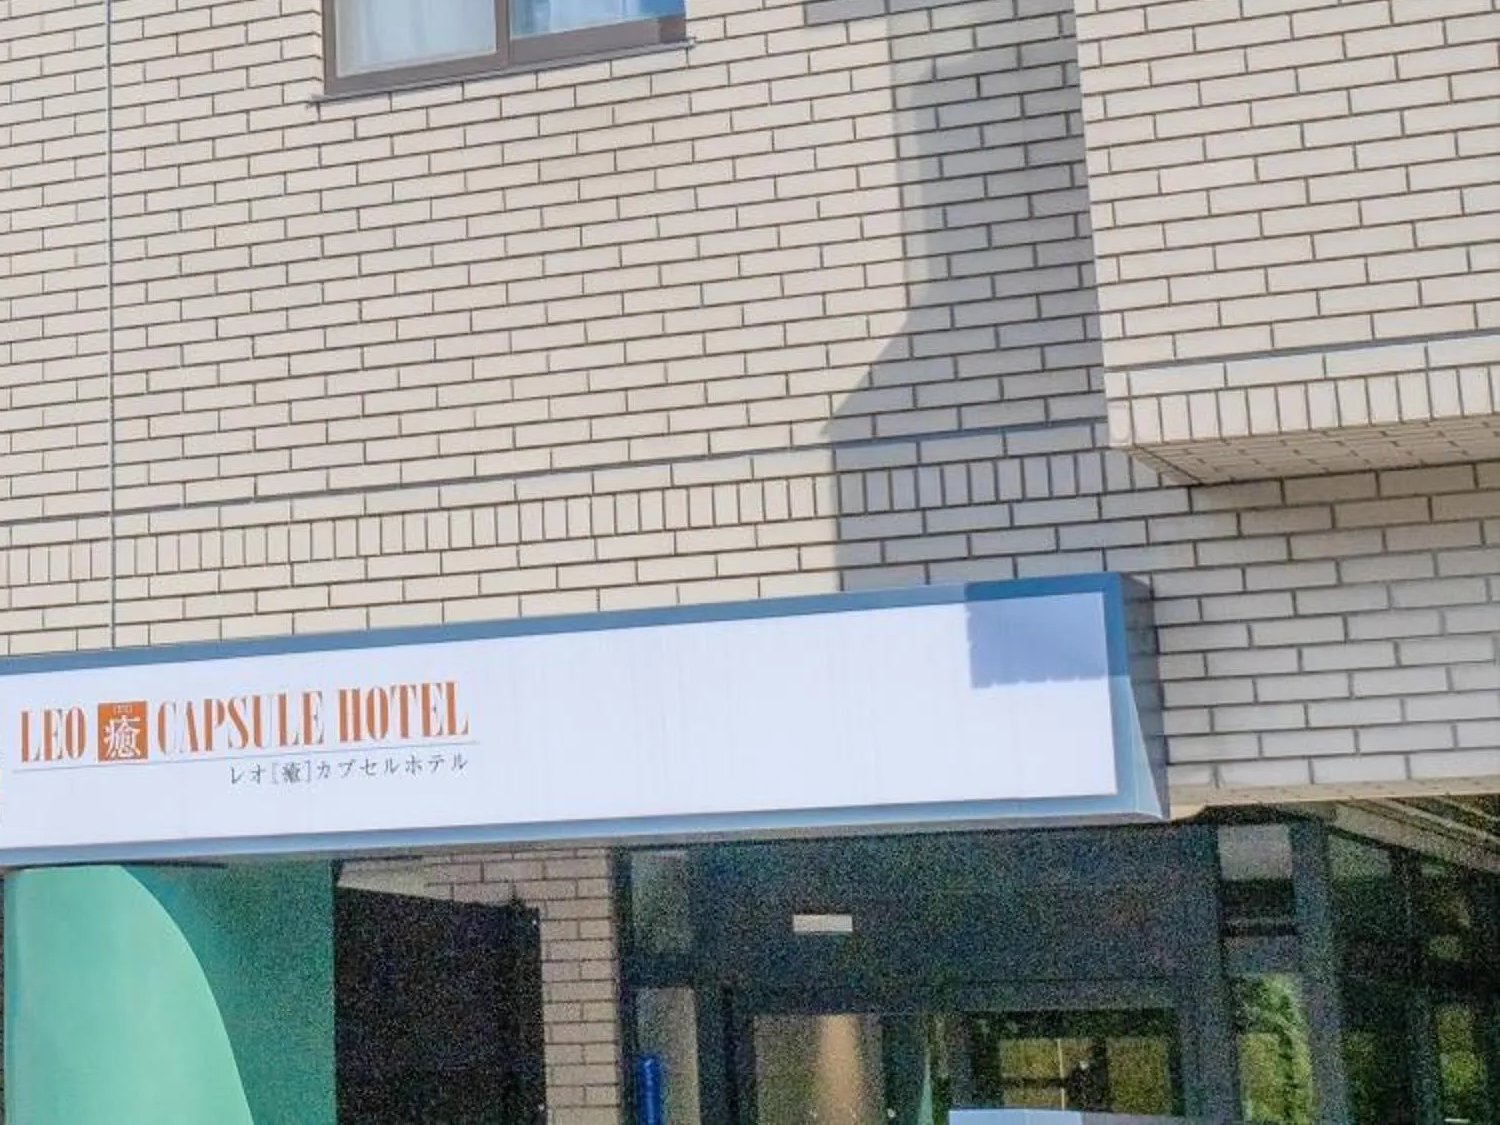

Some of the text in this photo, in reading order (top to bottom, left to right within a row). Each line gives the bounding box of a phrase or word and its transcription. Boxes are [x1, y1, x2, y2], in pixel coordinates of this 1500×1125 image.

[21, 706, 87, 763] LEO
[157, 690, 325, 755] CAPSULE
[338, 680, 469, 743] HOTEL
